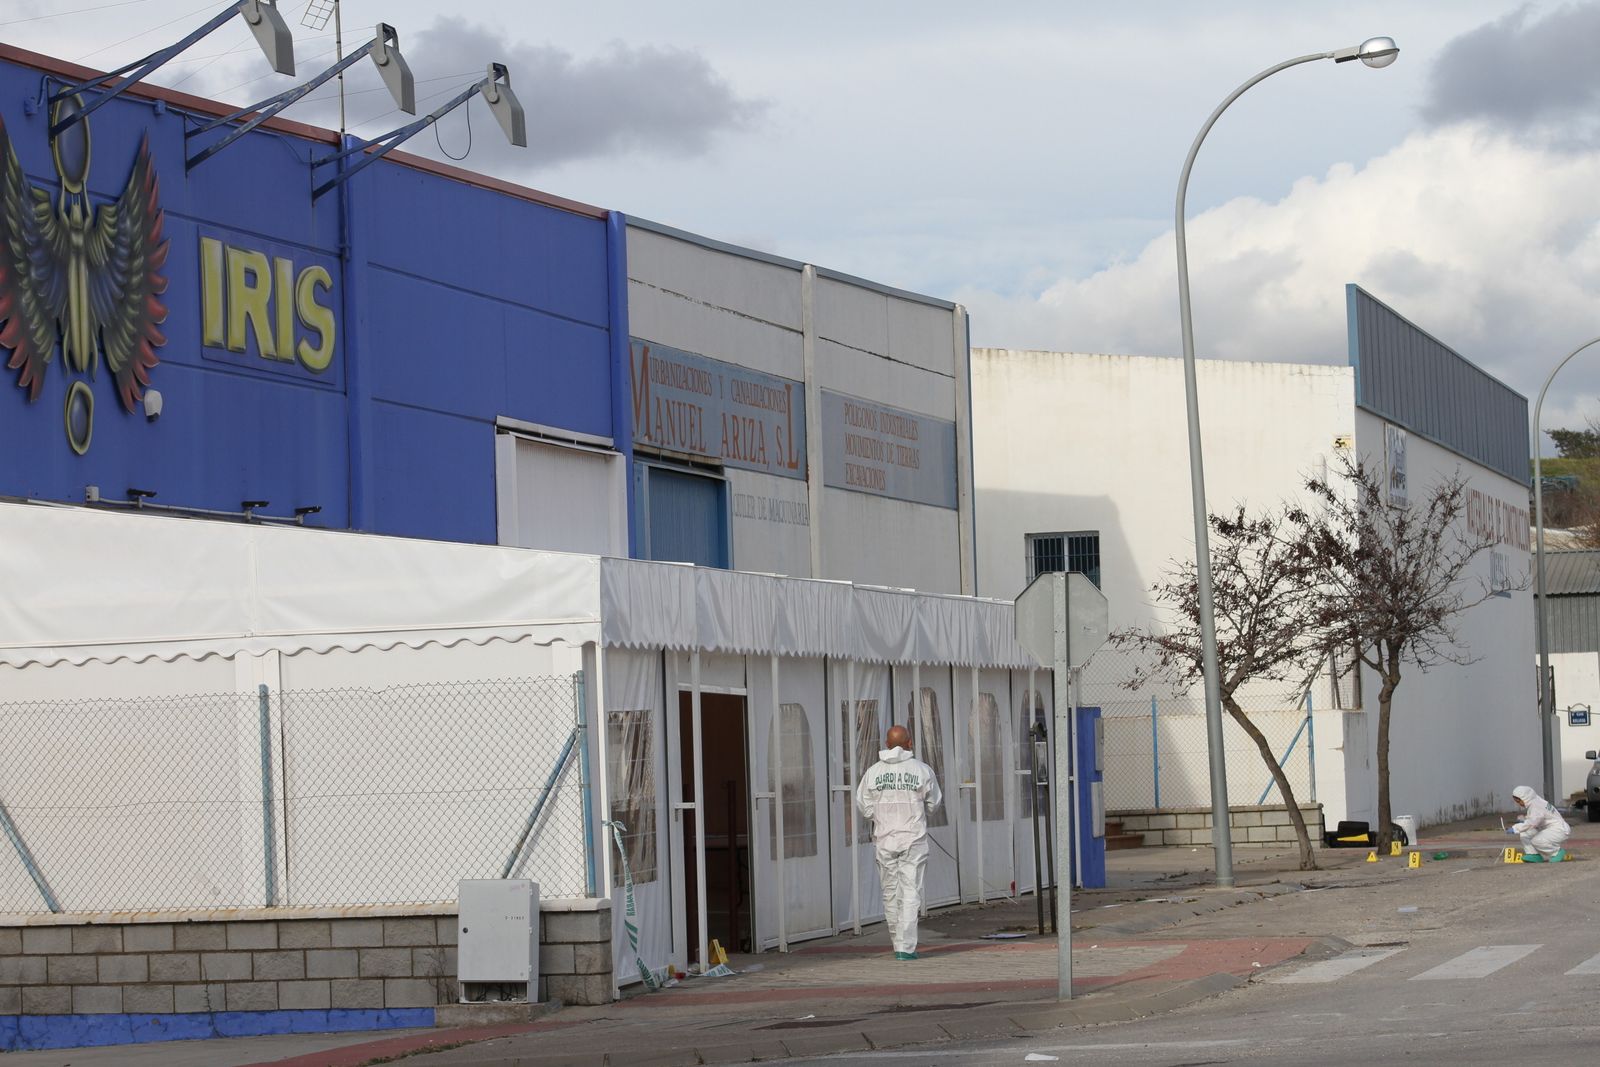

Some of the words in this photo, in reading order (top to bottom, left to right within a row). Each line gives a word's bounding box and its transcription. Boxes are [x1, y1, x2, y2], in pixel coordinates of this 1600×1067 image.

[201, 236, 336, 374] IRIS
[629, 341, 706, 453] MANUEL
[720, 412, 770, 471] ARIZA,
[650, 357, 712, 397] URBANIZACIONES
[718, 374, 724, 400] Y
[731, 378, 786, 414] CANALIZACIONES
[886, 442, 895, 465] DE
[896, 445, 920, 470] TIERRAS
[757, 496, 767, 520] DE
[768, 498, 810, 527] MAQUINARIA
[903, 772, 920, 785] CIVIL
